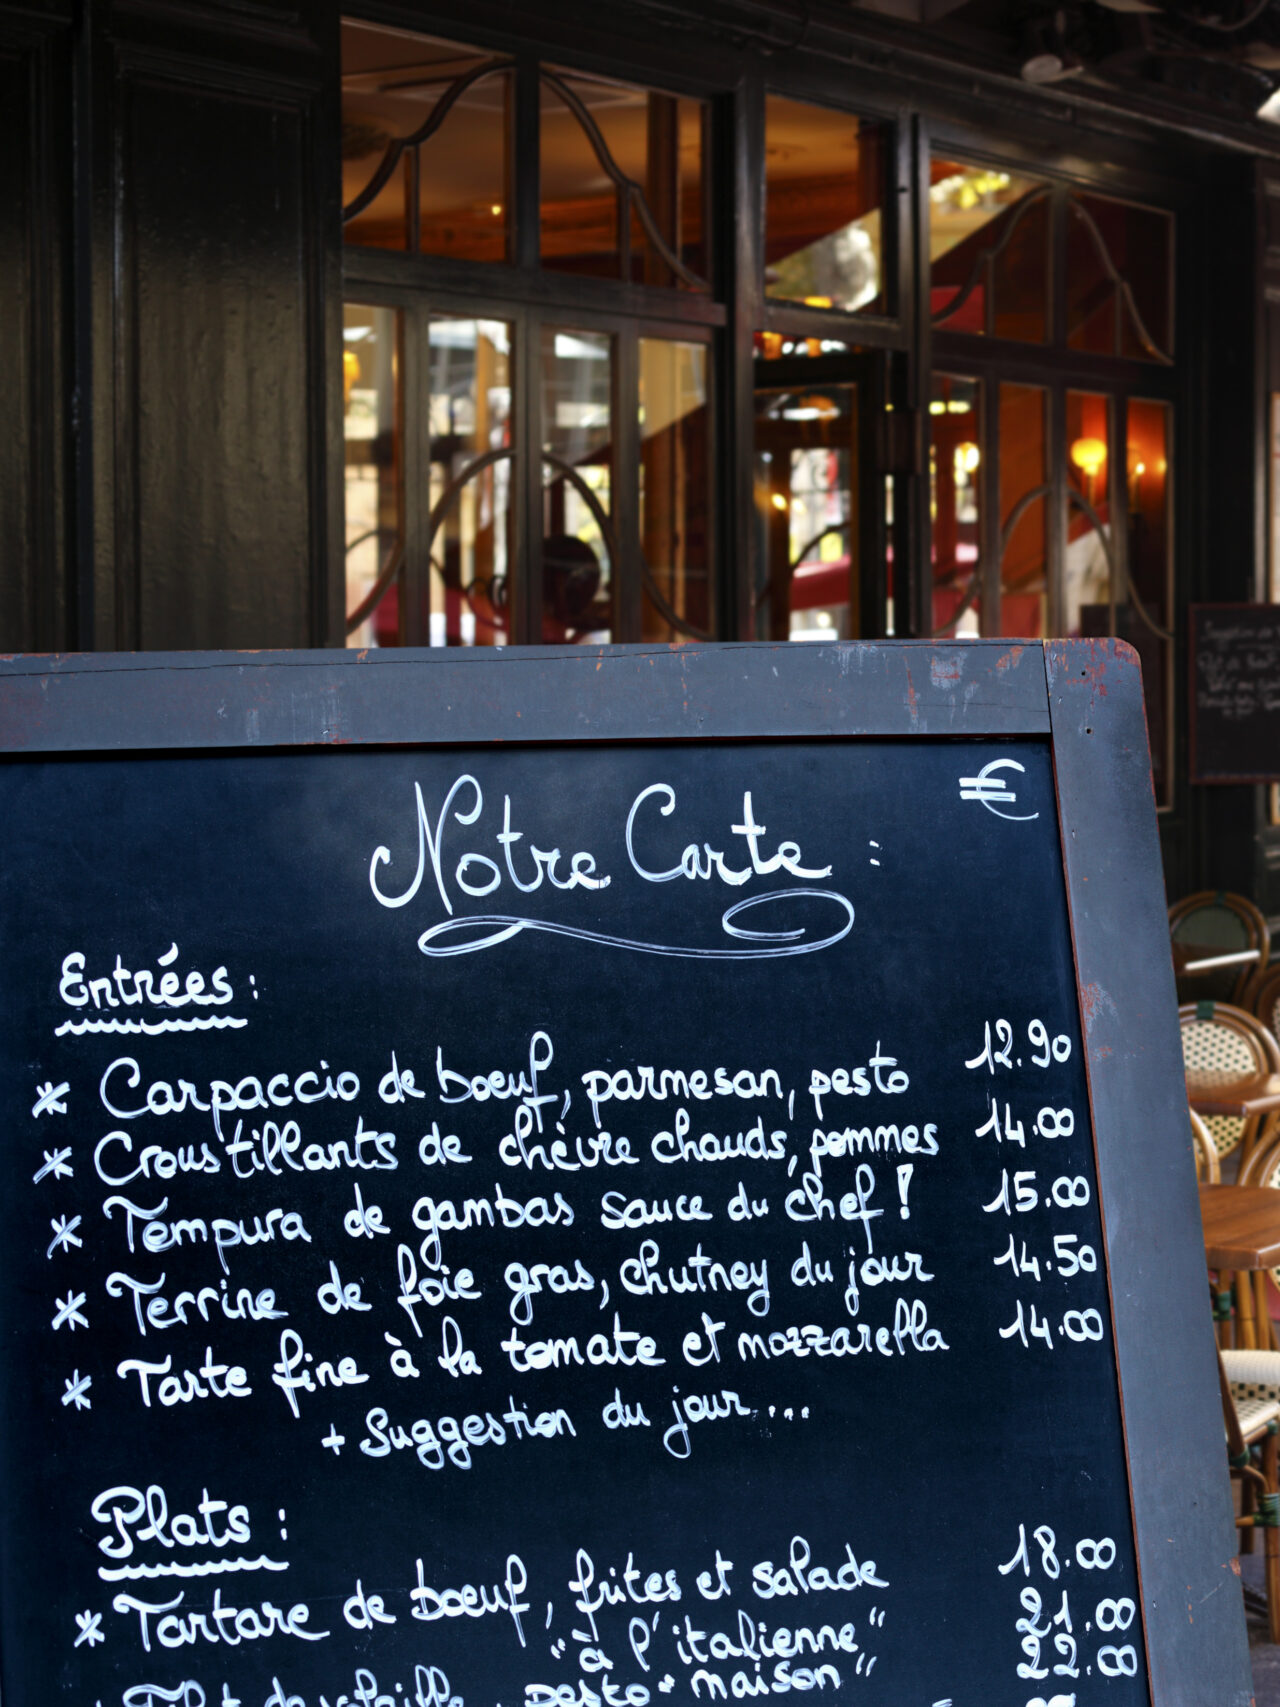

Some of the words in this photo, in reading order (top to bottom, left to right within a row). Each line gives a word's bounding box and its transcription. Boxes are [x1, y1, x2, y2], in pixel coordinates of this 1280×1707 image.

[370, 774, 612, 916] Notre
[626, 783, 832, 885] Carte
[965, 1018, 1072, 1076] 12.90
[99, 1057, 360, 1142] Carpaccio
[378, 1050, 426, 1104] de
[581, 1065, 796, 1129] parmesan,
[808, 1040, 910, 1121] pesto
[975, 1097, 1075, 1149] 14.00
[93, 1115, 399, 1187] Croustillants
[419, 1121, 473, 1166] de
[498, 1104, 640, 1170] chèvre
[651, 1108, 799, 1178] chauds,
[809, 1123, 940, 1178] pommes
[102, 1195, 312, 1276] Tempura
[343, 1182, 391, 1239] de
[411, 1182, 575, 1272] gambas
[727, 1181, 769, 1221] du
[982, 1168, 1091, 1217] 15.00
[105, 1271, 290, 1337] Terrine
[316, 1260, 372, 1314] de
[397, 1243, 483, 1338] foie
[504, 1259, 610, 1326] gras,
[619, 1239, 771, 1317] chutney
[791, 1241, 834, 1286] du
[844, 1246, 935, 1317] jour
[993, 1233, 1097, 1282] 14.50
[116, 1346, 253, 1408] Tarte
[271, 1329, 370, 1419] fine
[384, 1331, 421, 1378] à
[438, 1315, 483, 1378] la
[500, 1311, 667, 1373] tomate
[682, 1312, 727, 1367] et
[737, 1298, 950, 1361] mozzarella
[998, 1299, 1104, 1350] 14.00
[359, 1395, 577, 1470] Suggestion
[602, 1387, 651, 1429] du
[91, 1485, 251, 1559] Plats
[998, 1523, 1117, 1580] 18.00
[112, 1588, 330, 1653] Tartare
[343, 1578, 397, 1630] de
[568, 1548, 683, 1642] frites
[696, 1549, 734, 1600] et
[752, 1535, 890, 1599] salade
[1015, 1586, 1136, 1638] 21.00
[1016, 1632, 1138, 1680] 22.00
